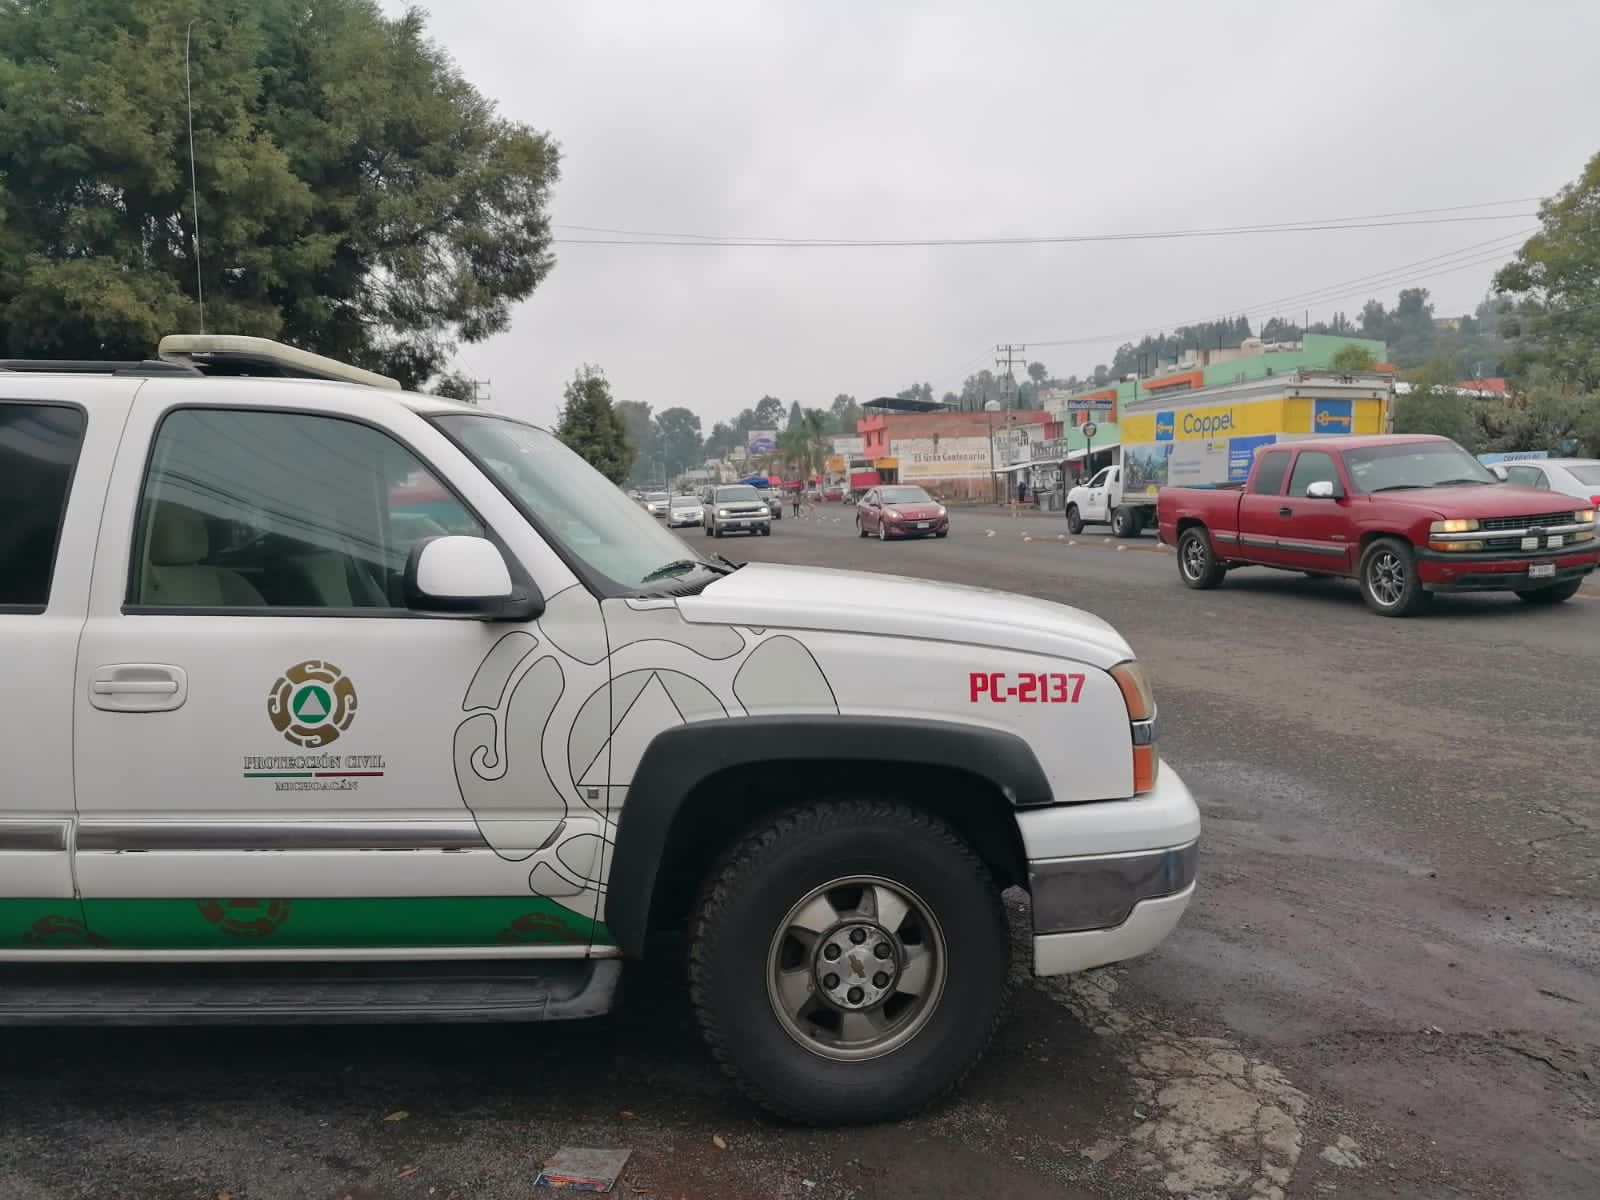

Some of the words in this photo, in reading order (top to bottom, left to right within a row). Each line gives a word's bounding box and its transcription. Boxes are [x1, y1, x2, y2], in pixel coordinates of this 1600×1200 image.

[1183, 407, 1236, 439] Coppel
[942, 451, 986, 461] Centenario
[969, 672, 1086, 703] PC-2137
[243, 752, 341, 769] PROTECCIÓN
[345, 755, 386, 769] CIVIL
[275, 779, 359, 791] MICHOACÁN
